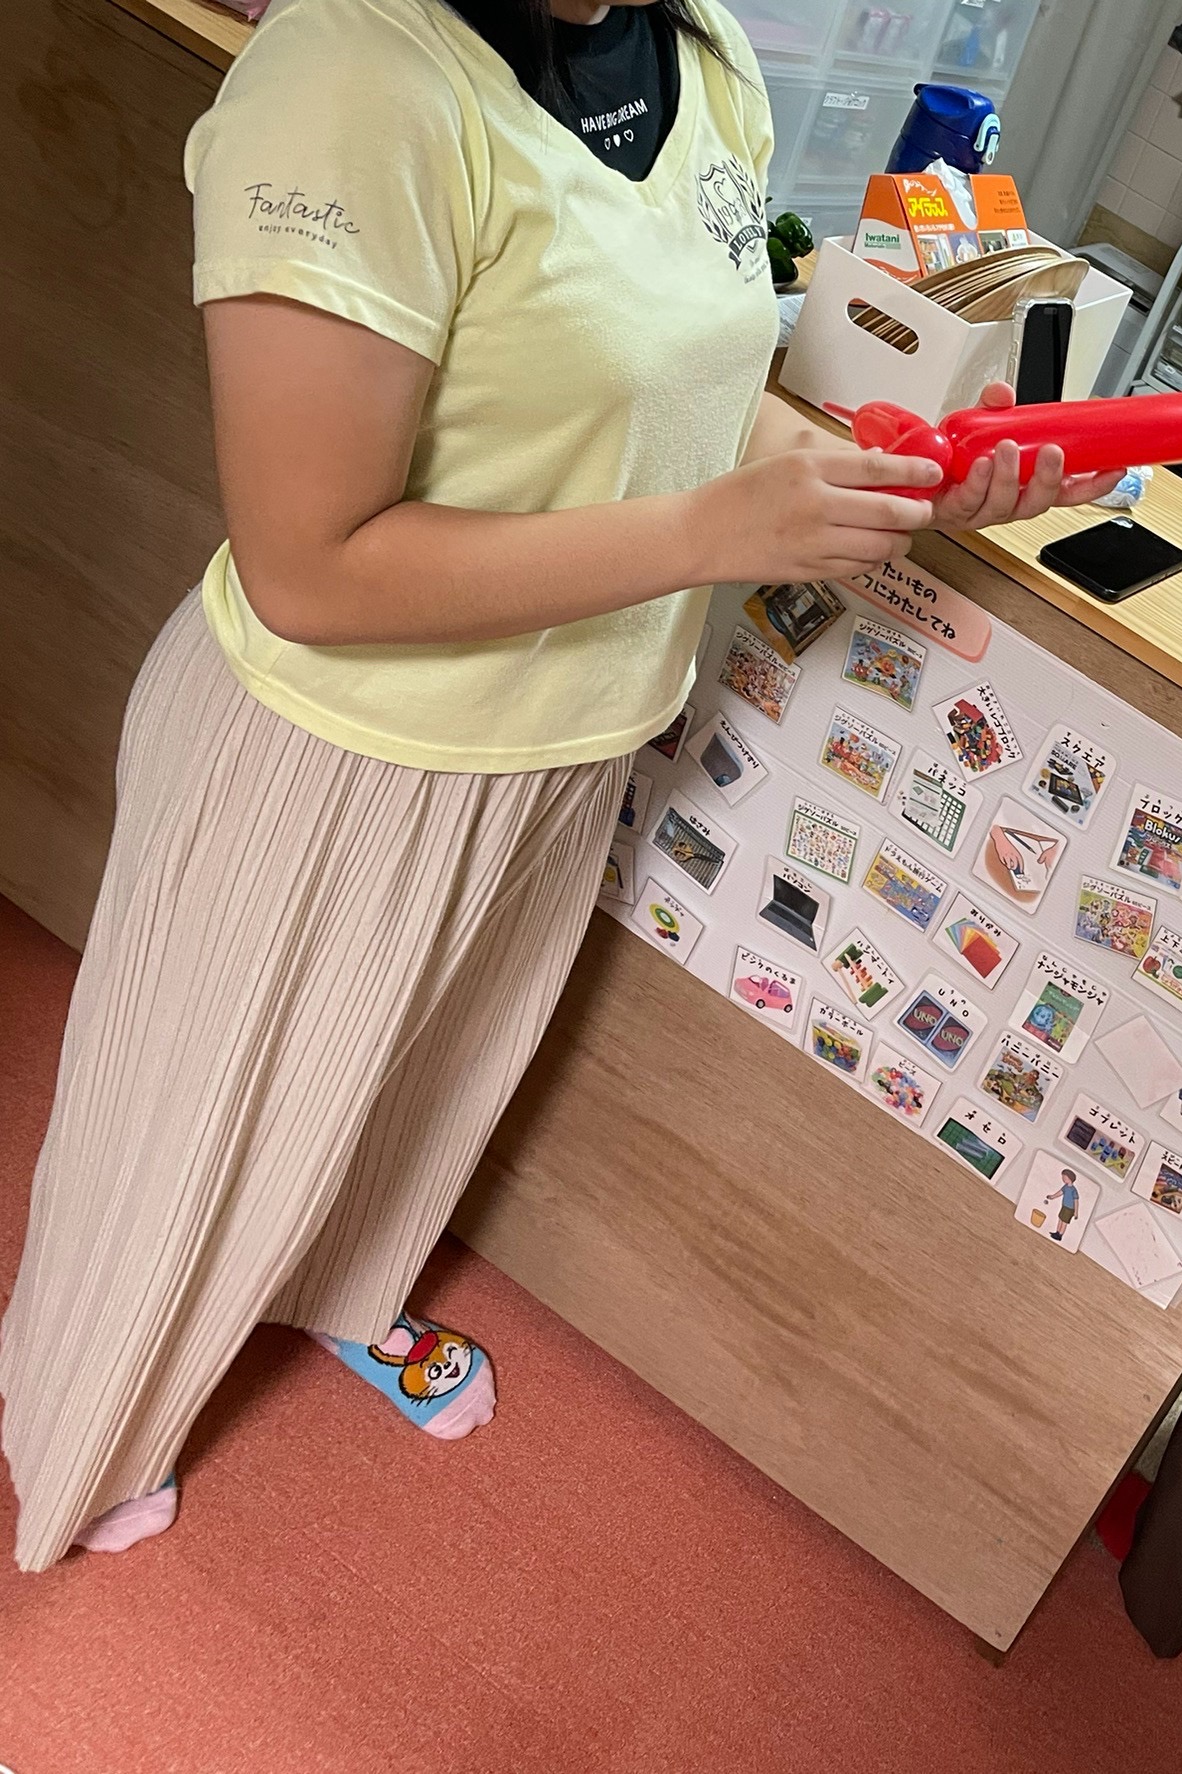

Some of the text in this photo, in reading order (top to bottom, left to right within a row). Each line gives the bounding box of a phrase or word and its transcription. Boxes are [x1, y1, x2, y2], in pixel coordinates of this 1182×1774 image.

[581, 114, 606, 133] HAVE
[244, 183, 360, 233] Fantastic
[285, 226, 337, 249] everyday
[865, 232, 900, 243] Iwatani
[736, 632, 778, 663] ジグソーパズル
[834, 715, 878, 743] ジグソーパズル
[976, 686, 1016, 759] 大きいレゴブロック
[719, 720, 759, 769] えんぴつけずり
[1061, 738, 1103, 768] スクエア
[689, 816, 710, 835] はさみ
[798, 804, 838, 827] ジグソーパズル
[783, 872, 811, 892] パソコン
[884, 846, 942, 891] ドラえもん旅行ゲーム
[1083, 882, 1130, 903] ジグソーパズル
[970, 909, 1001, 936] おりがみ
[1036, 961, 1103, 1005] ナンジャモンジャ
[913, 1010, 936, 1026] UNO
[940, 1030, 963, 1046] UNO
[1001, 1038, 1059, 1078] ハニーバニー
[964, 1112, 1006, 1144] オセロ
[1088, 1108, 1137, 1144] ゴブレット
